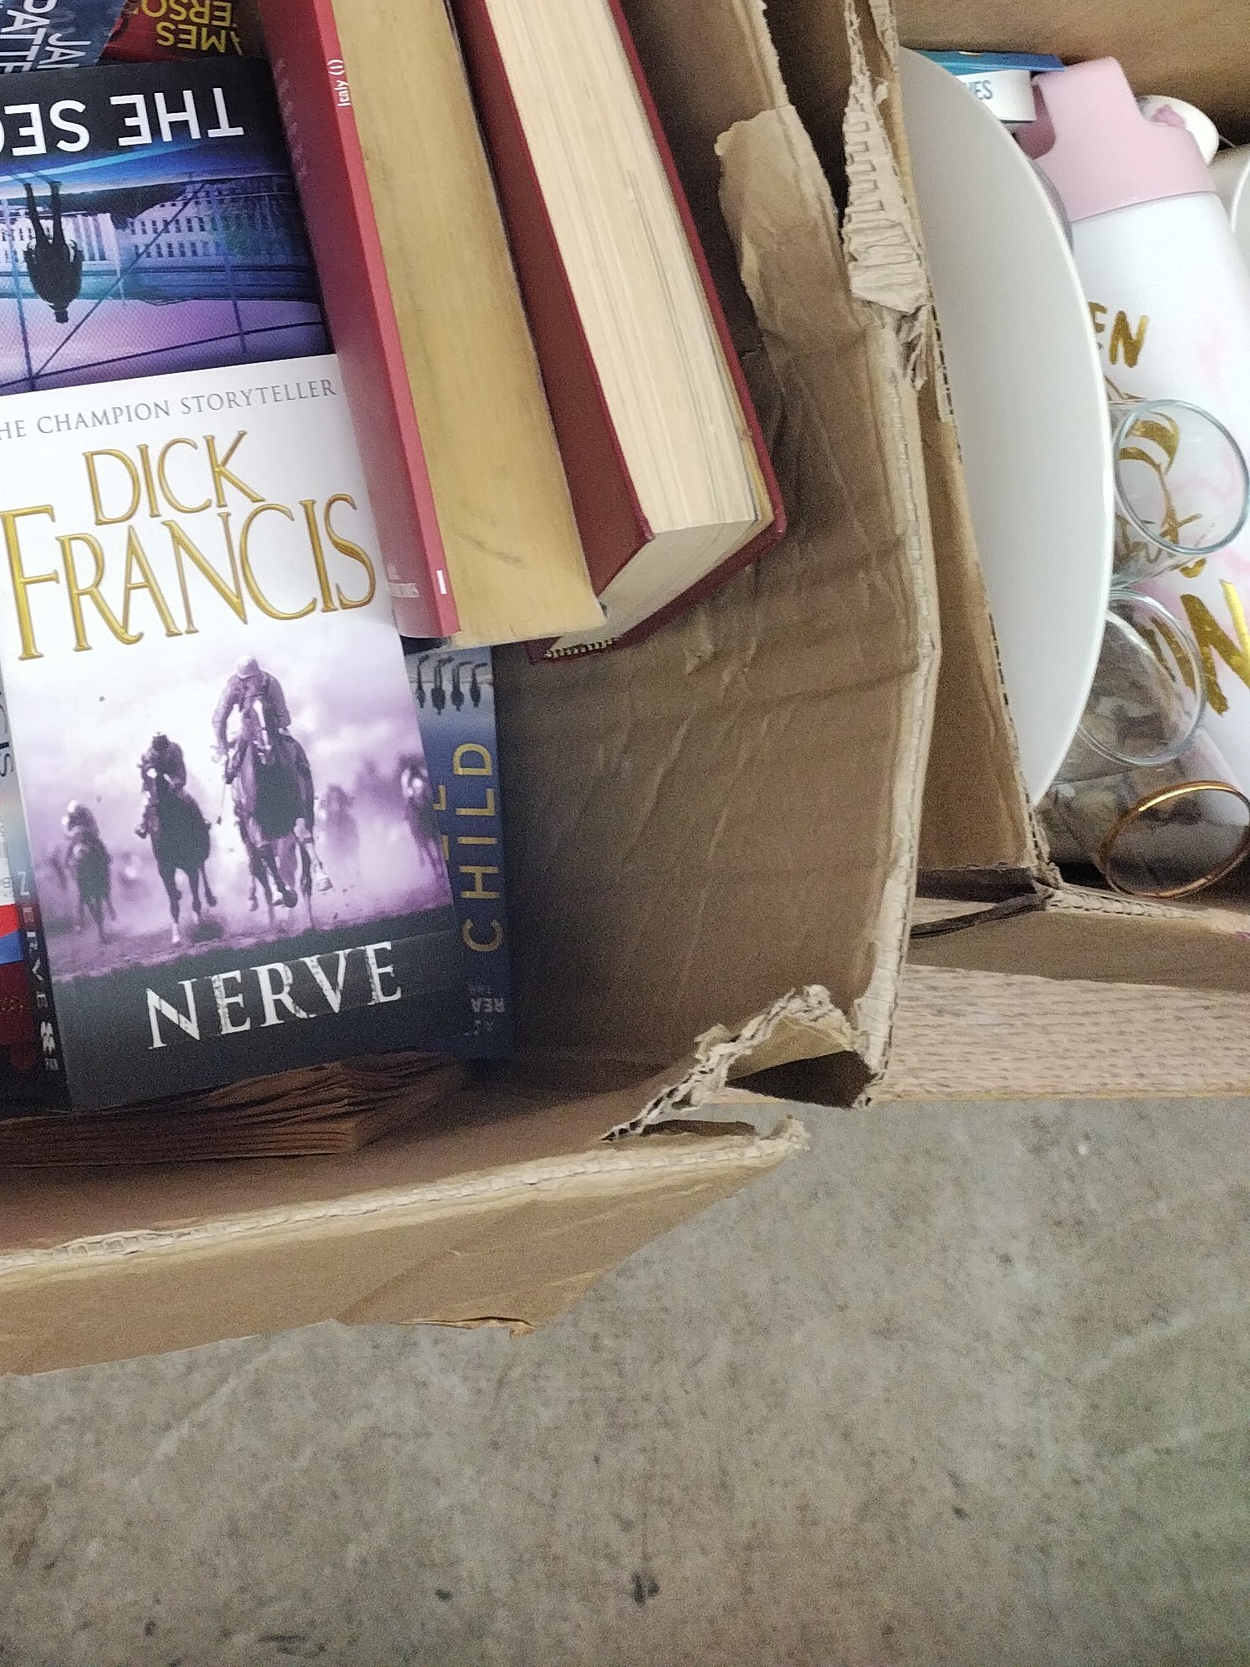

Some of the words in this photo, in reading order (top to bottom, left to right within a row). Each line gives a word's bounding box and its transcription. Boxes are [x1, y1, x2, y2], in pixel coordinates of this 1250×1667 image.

[109, 87, 246, 147] THE
[333, 79, 352, 108] Italy
[35, 399, 172, 437] CHAMPION
[180, 378, 338, 416] STORYTELLER
[82, 429, 266, 527] DICK
[451, 742, 506, 954] CHILD
[16, 870, 50, 1011] NERVE
[146, 941, 403, 1050] NERVE
